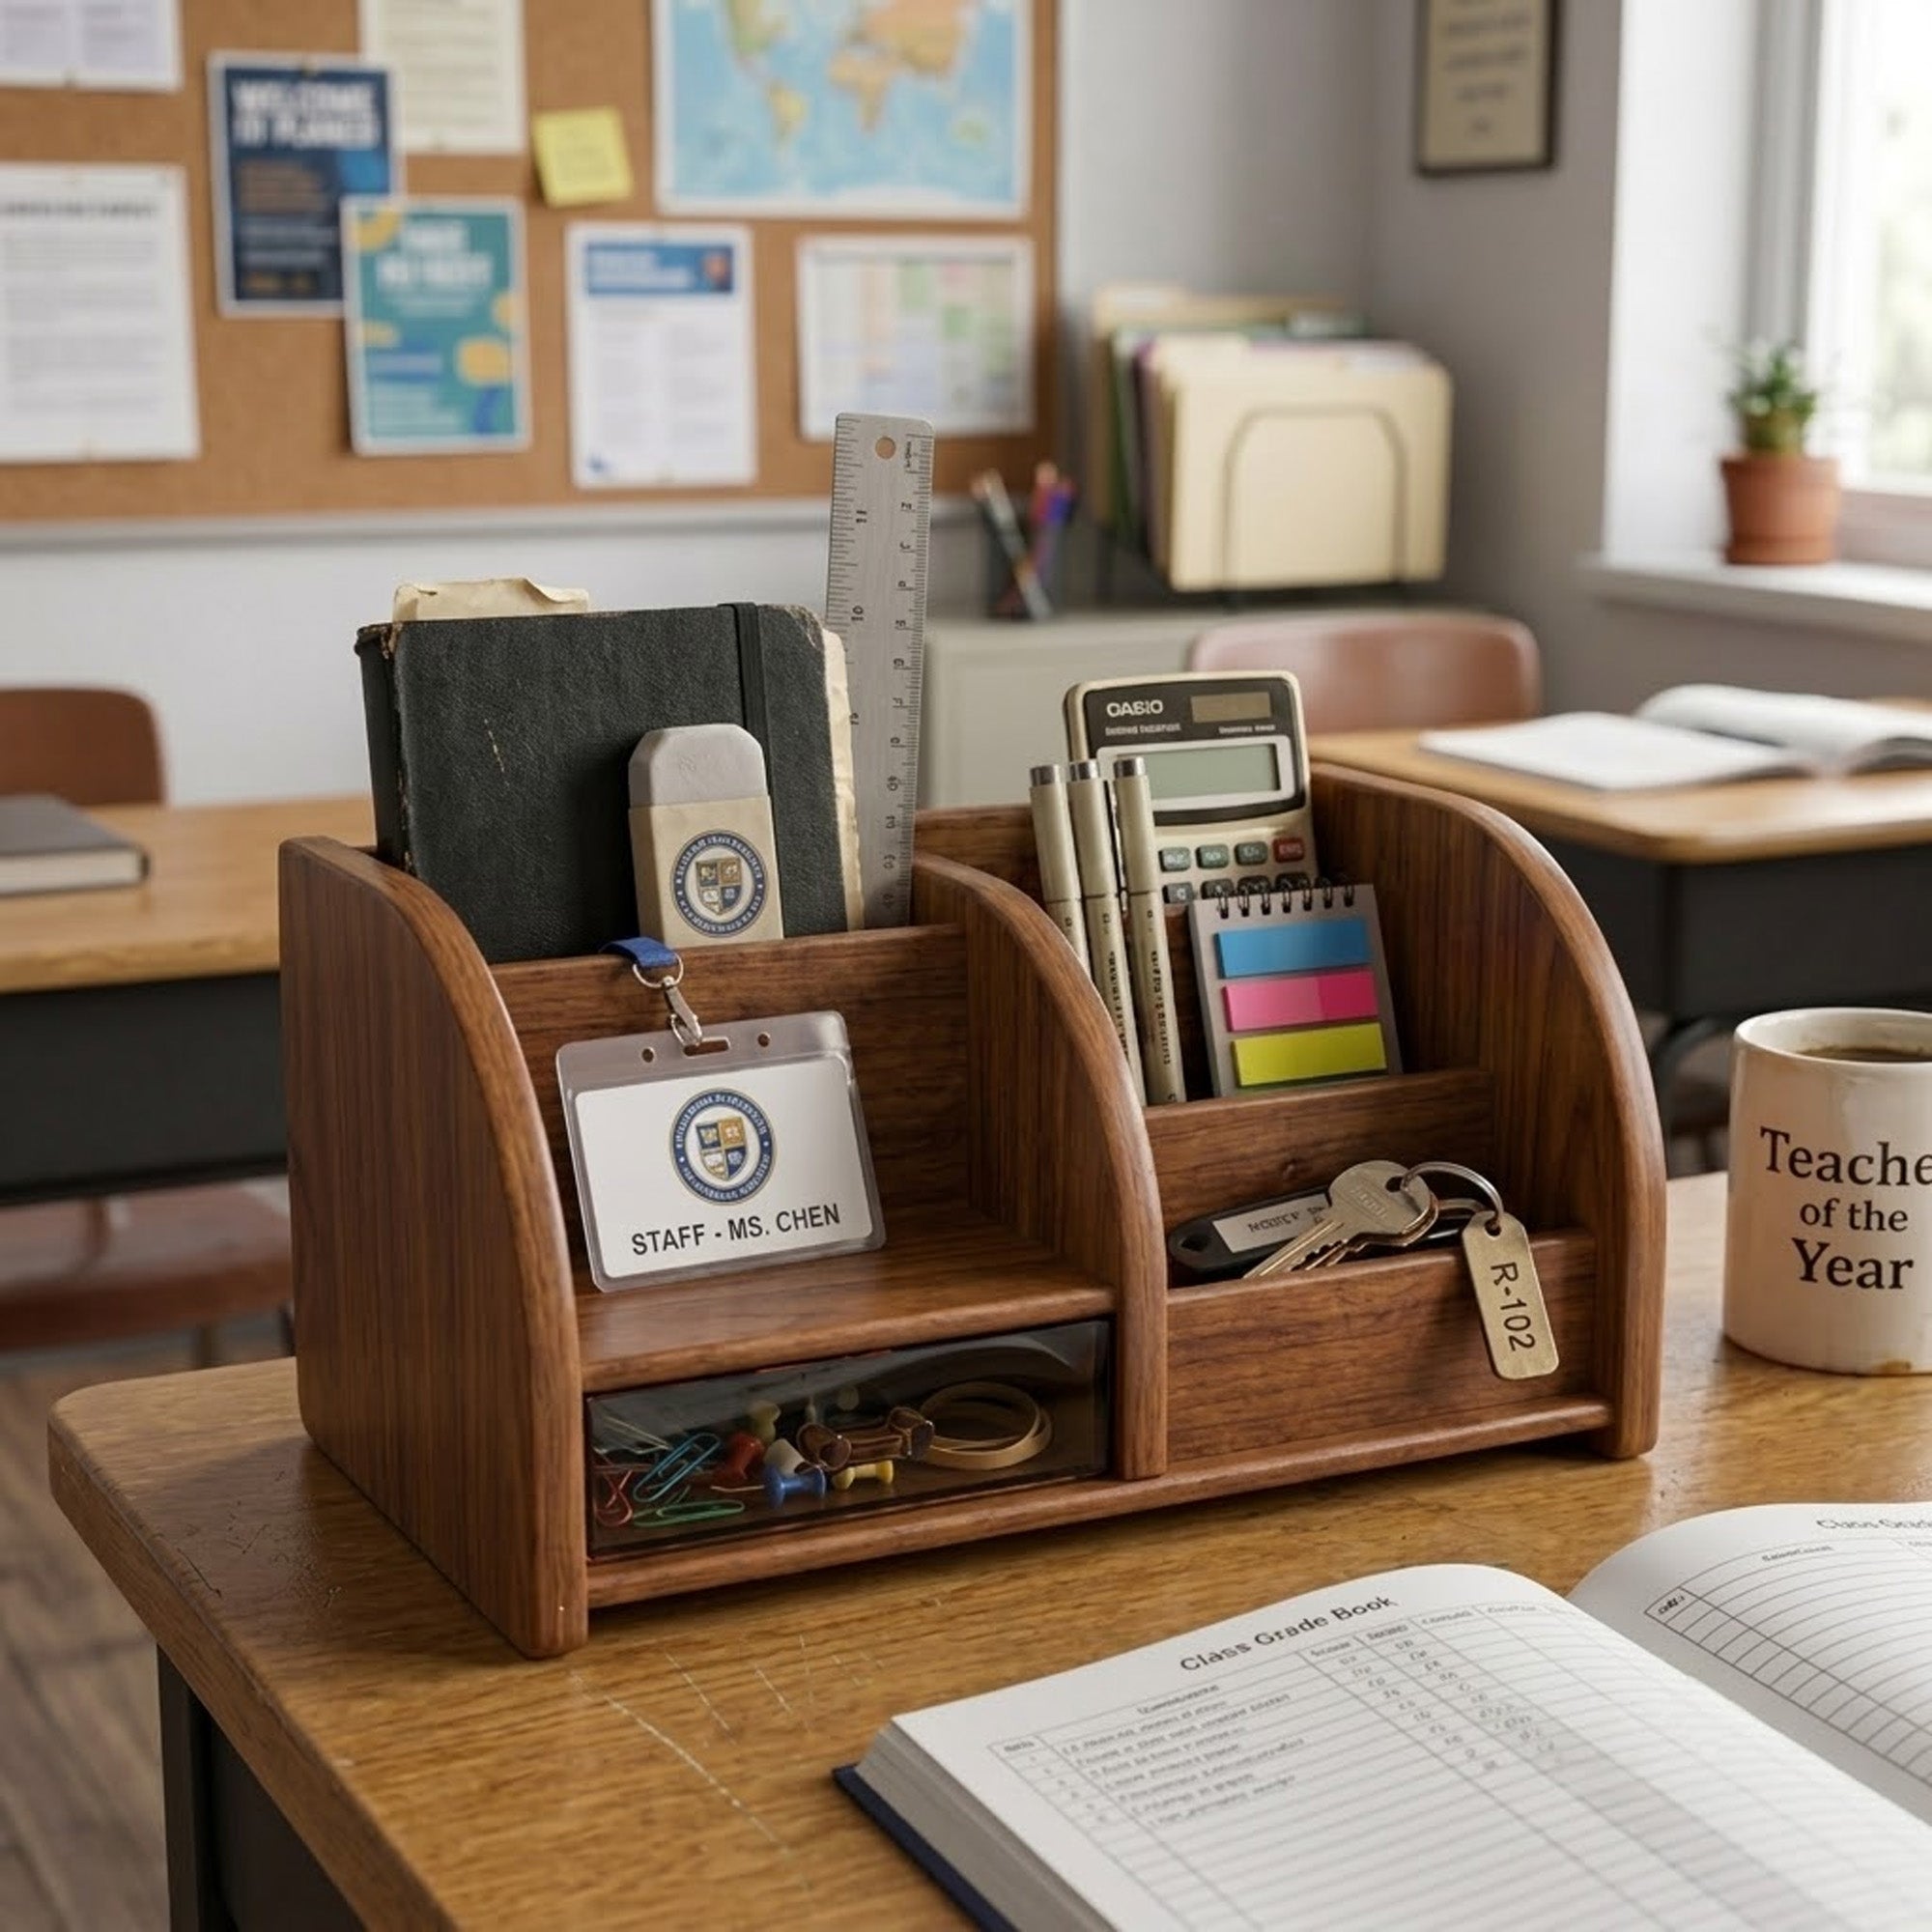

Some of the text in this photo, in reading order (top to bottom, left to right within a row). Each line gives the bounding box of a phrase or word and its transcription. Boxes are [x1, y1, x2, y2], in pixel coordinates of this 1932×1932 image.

[1107, 699, 1164, 718] CASIO
[1760, 1125, 1932, 1186] Teache
[632, 1224, 705, 1255] STAFF
[728, 1216, 770, 1240] MS.
[776, 1204, 840, 1232] CHEN
[1800, 1198, 1908, 1232] of the
[1791, 1237, 1914, 1290] Year
[1491, 1262, 1536, 1351] R-102
[1179, 1642, 1252, 1671] Class
[1254, 1616, 1328, 1645] Grade
[1330, 1596, 1398, 1622] Book
